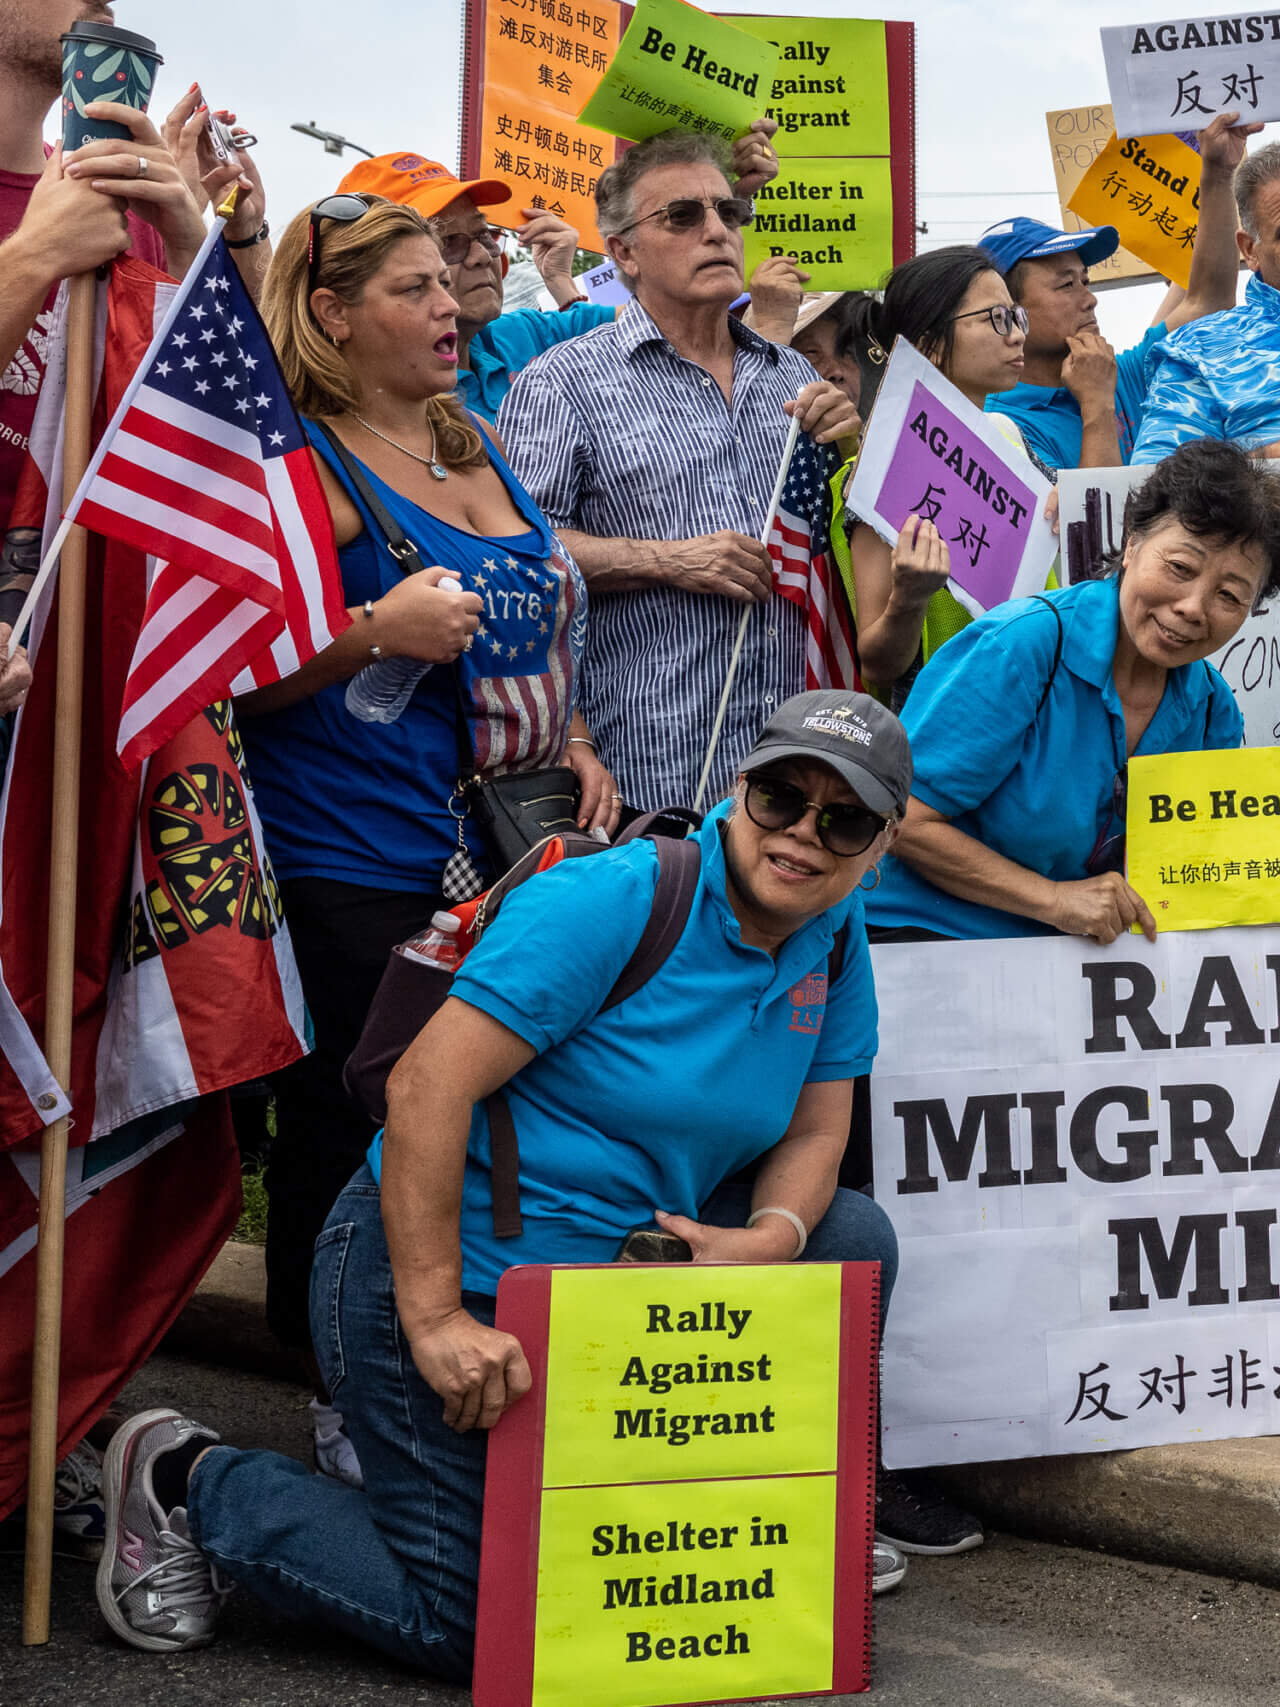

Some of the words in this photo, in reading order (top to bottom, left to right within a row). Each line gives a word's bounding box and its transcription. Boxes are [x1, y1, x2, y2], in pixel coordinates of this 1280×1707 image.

[499, 15, 608, 73] 滩反对游民所
[640, 26, 676, 61] Be
[681, 44, 759, 98] Heard
[767, 41, 830, 65] ally
[538, 63, 573, 96] 集会
[771, 75, 846, 99] gainst
[1170, 64, 1264, 117] 反对
[496, 113, 604, 167] 史丹顿岛中区
[1055, 107, 1111, 136] OUR
[1120, 138, 1189, 196] Stand
[840, 181, 864, 200] in
[754, 214, 856, 232] Midland
[909, 410, 1027, 528] AGAINST
[485, 588, 542, 620] 1776
[1149, 794, 1197, 823] Be
[646, 1302, 752, 1339] Rally
[619, 1354, 772, 1394] Against
[613, 1405, 775, 1446] Migrant
[591, 1521, 738, 1557] Shelter
[750, 1516, 789, 1547] in
[603, 1568, 775, 1610] Midland
[625, 1625, 750, 1663] Beach
